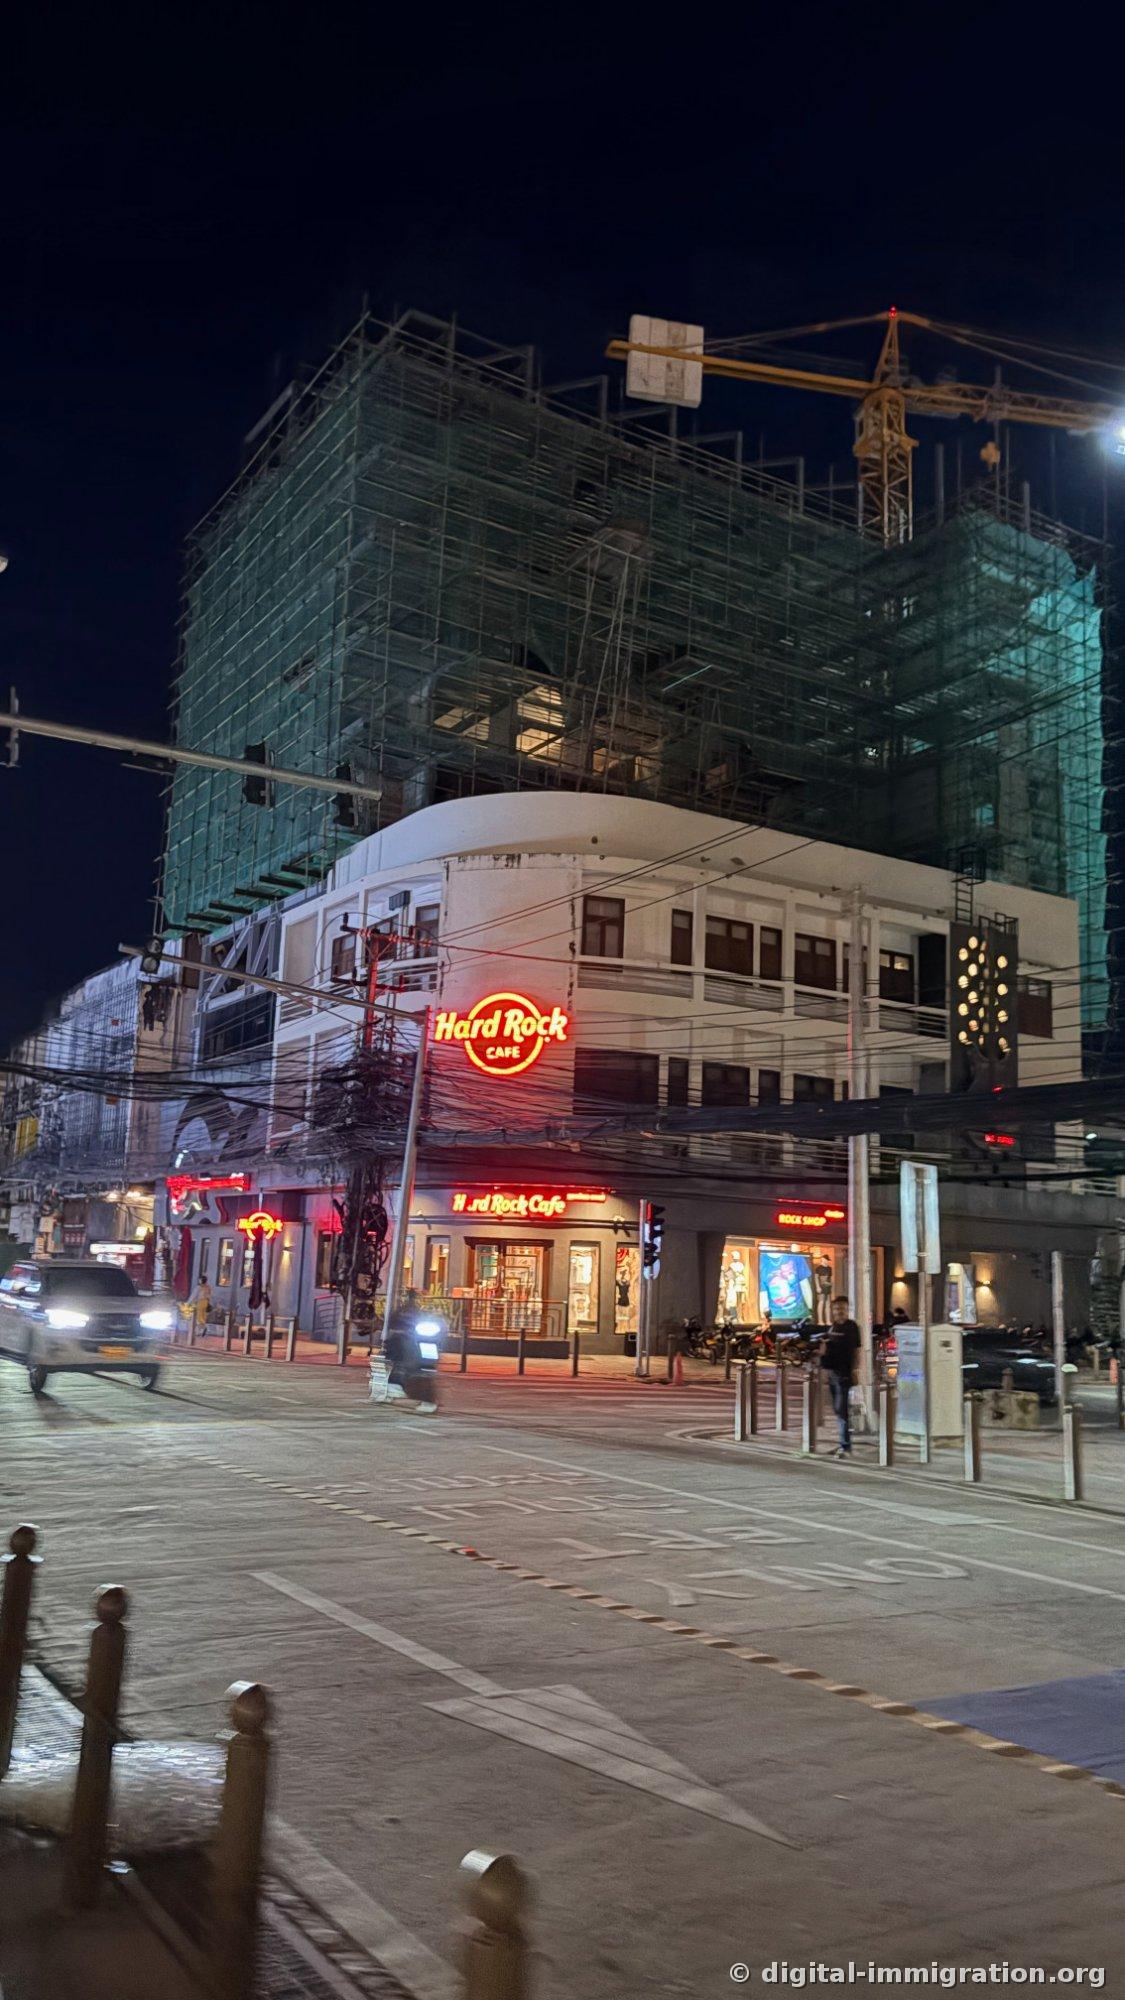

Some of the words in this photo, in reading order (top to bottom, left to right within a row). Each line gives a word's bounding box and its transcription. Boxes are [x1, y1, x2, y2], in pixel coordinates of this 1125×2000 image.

[434, 1009, 503, 1040] Hard
[502, 1006, 568, 1043] Rock
[485, 1046, 521, 1060] CAFE
[490, 1193, 528, 1216] Rock
[528, 1194, 567, 1217] Cafe
[645, 1556, 971, 1608] ONLY
